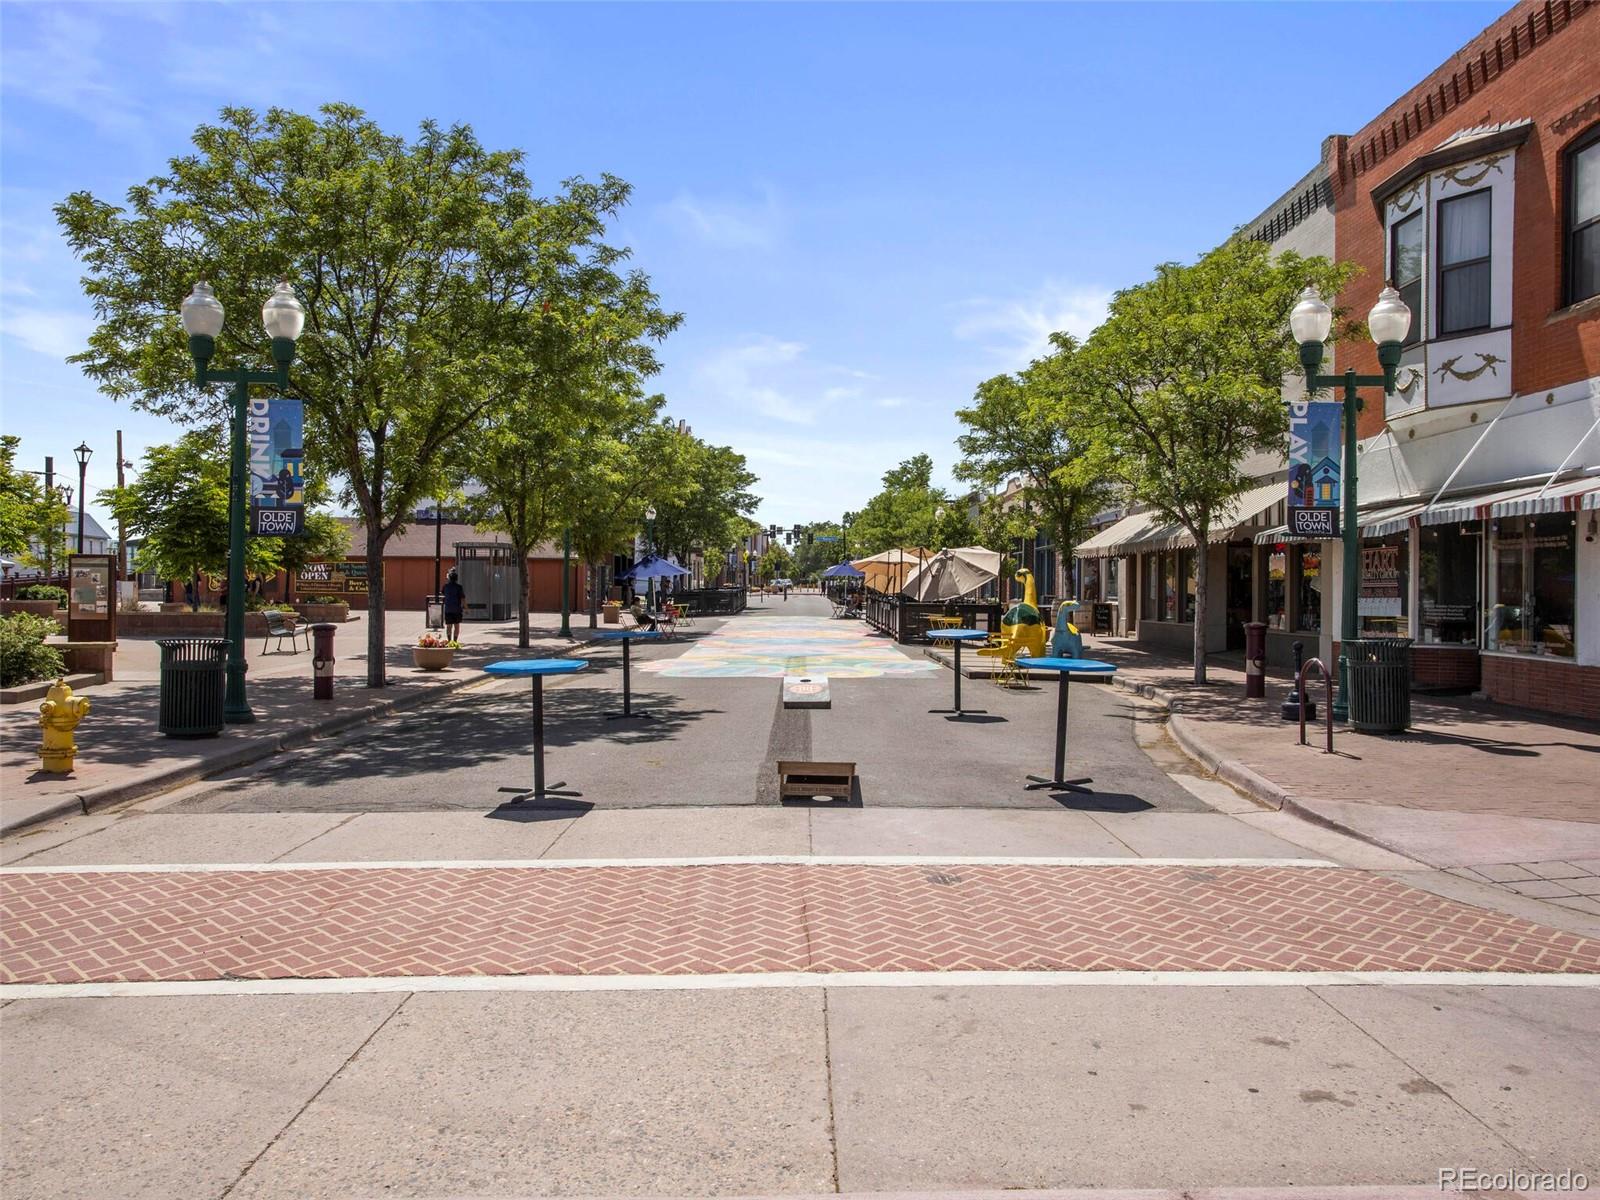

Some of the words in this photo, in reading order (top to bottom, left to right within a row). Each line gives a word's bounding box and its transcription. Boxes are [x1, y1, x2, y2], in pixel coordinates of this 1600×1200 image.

[1289, 401, 1308, 464] PLAY
[262, 512, 292, 522] OLDE
[1298, 512, 1328, 522] OLDE
[260, 521, 294, 531] TOWN
[1297, 521, 1330, 531] TOWN
[1362, 550, 1398, 569] HART
[303, 563, 328, 572] NOW
[300, 571, 329, 580] OPEN
